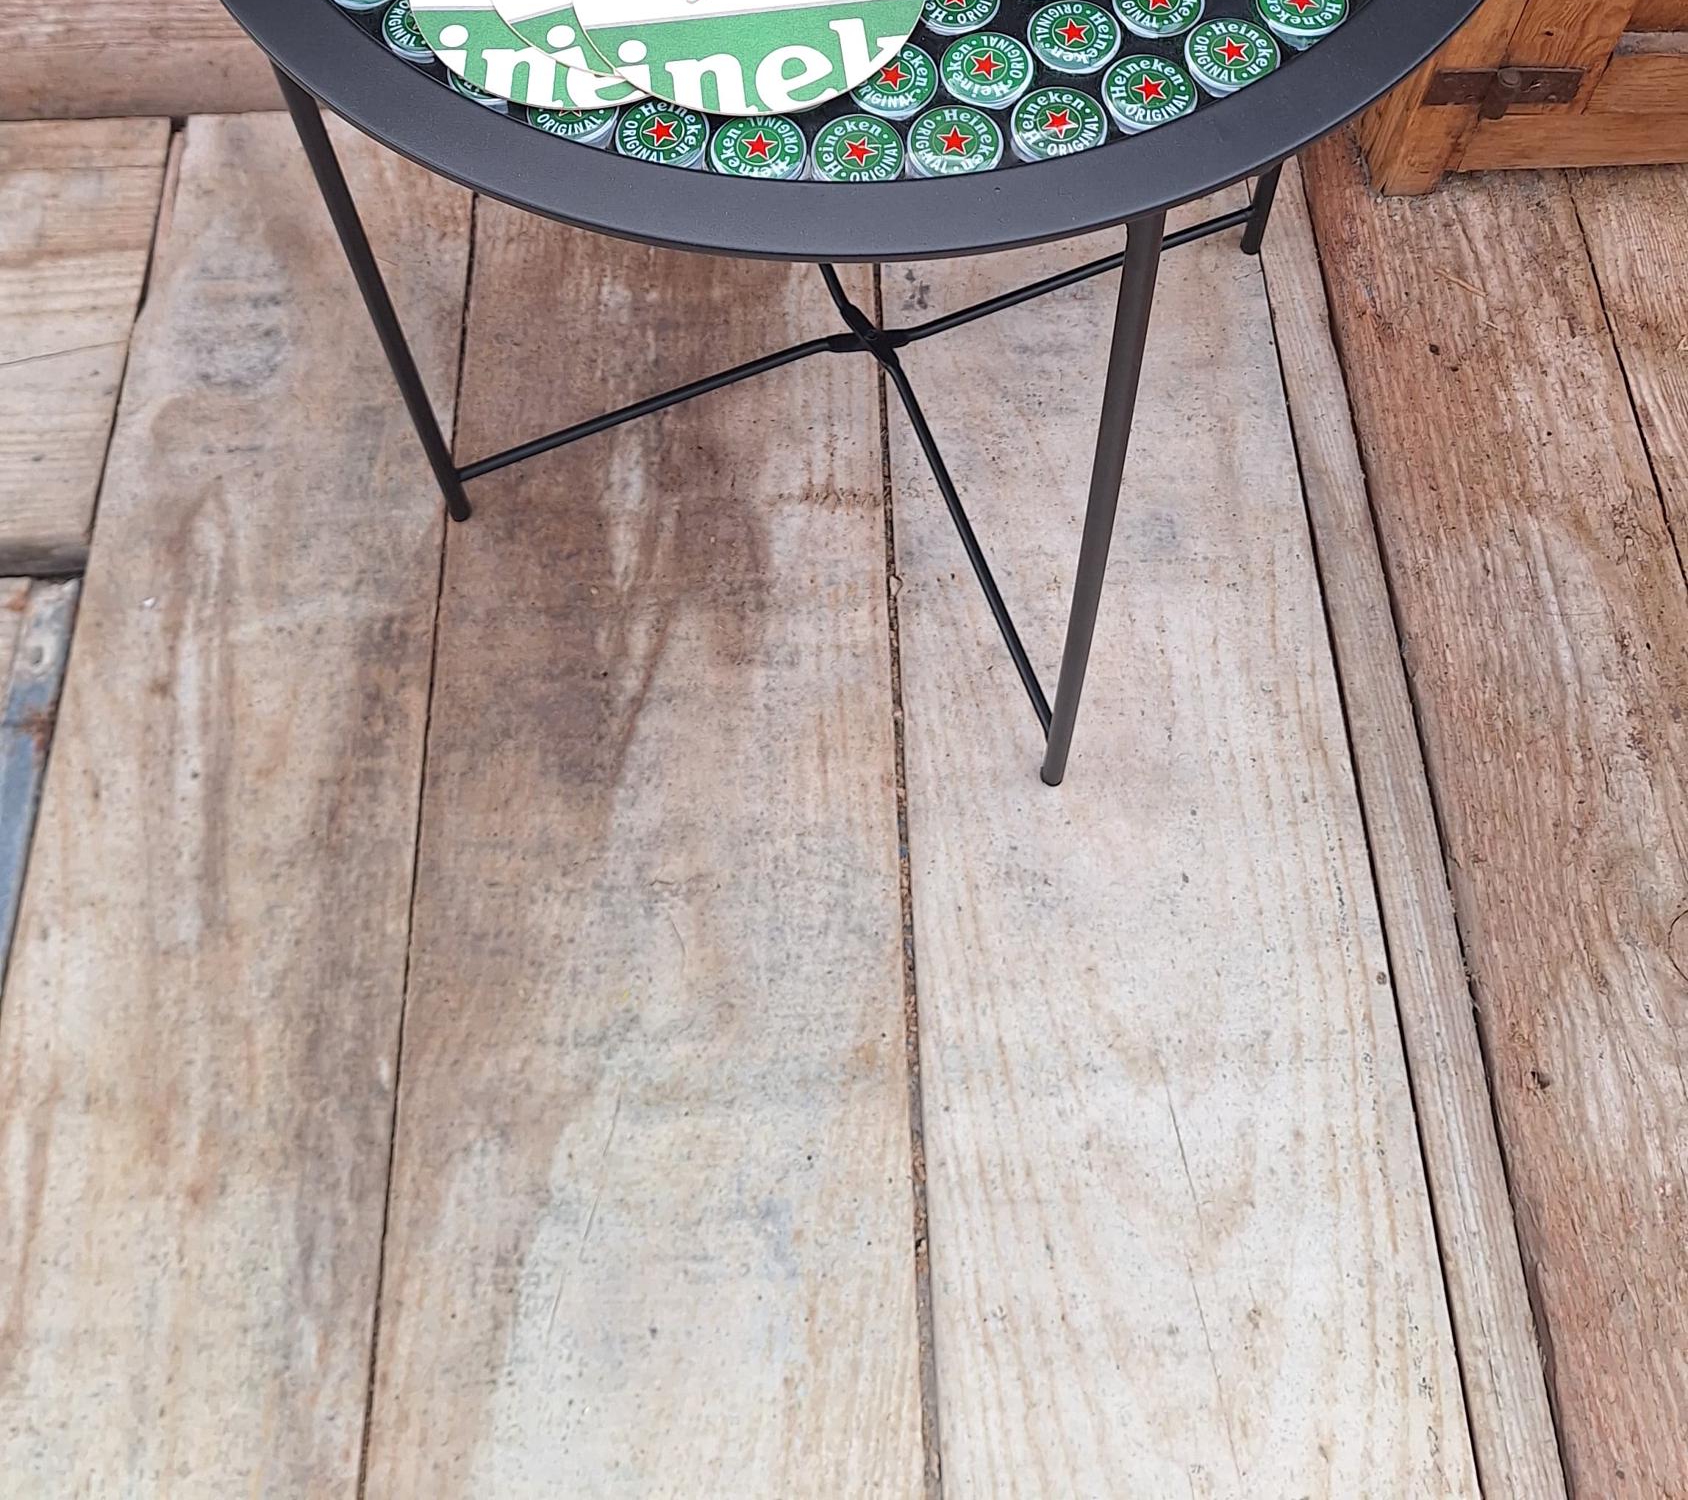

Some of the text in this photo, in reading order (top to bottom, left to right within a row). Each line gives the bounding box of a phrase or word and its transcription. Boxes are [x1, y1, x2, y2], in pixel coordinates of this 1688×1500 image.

[1189, 19, 1272, 83] Heineken ORIGINAL
[1108, 58, 1191, 124] Heineken ORIGINAL
